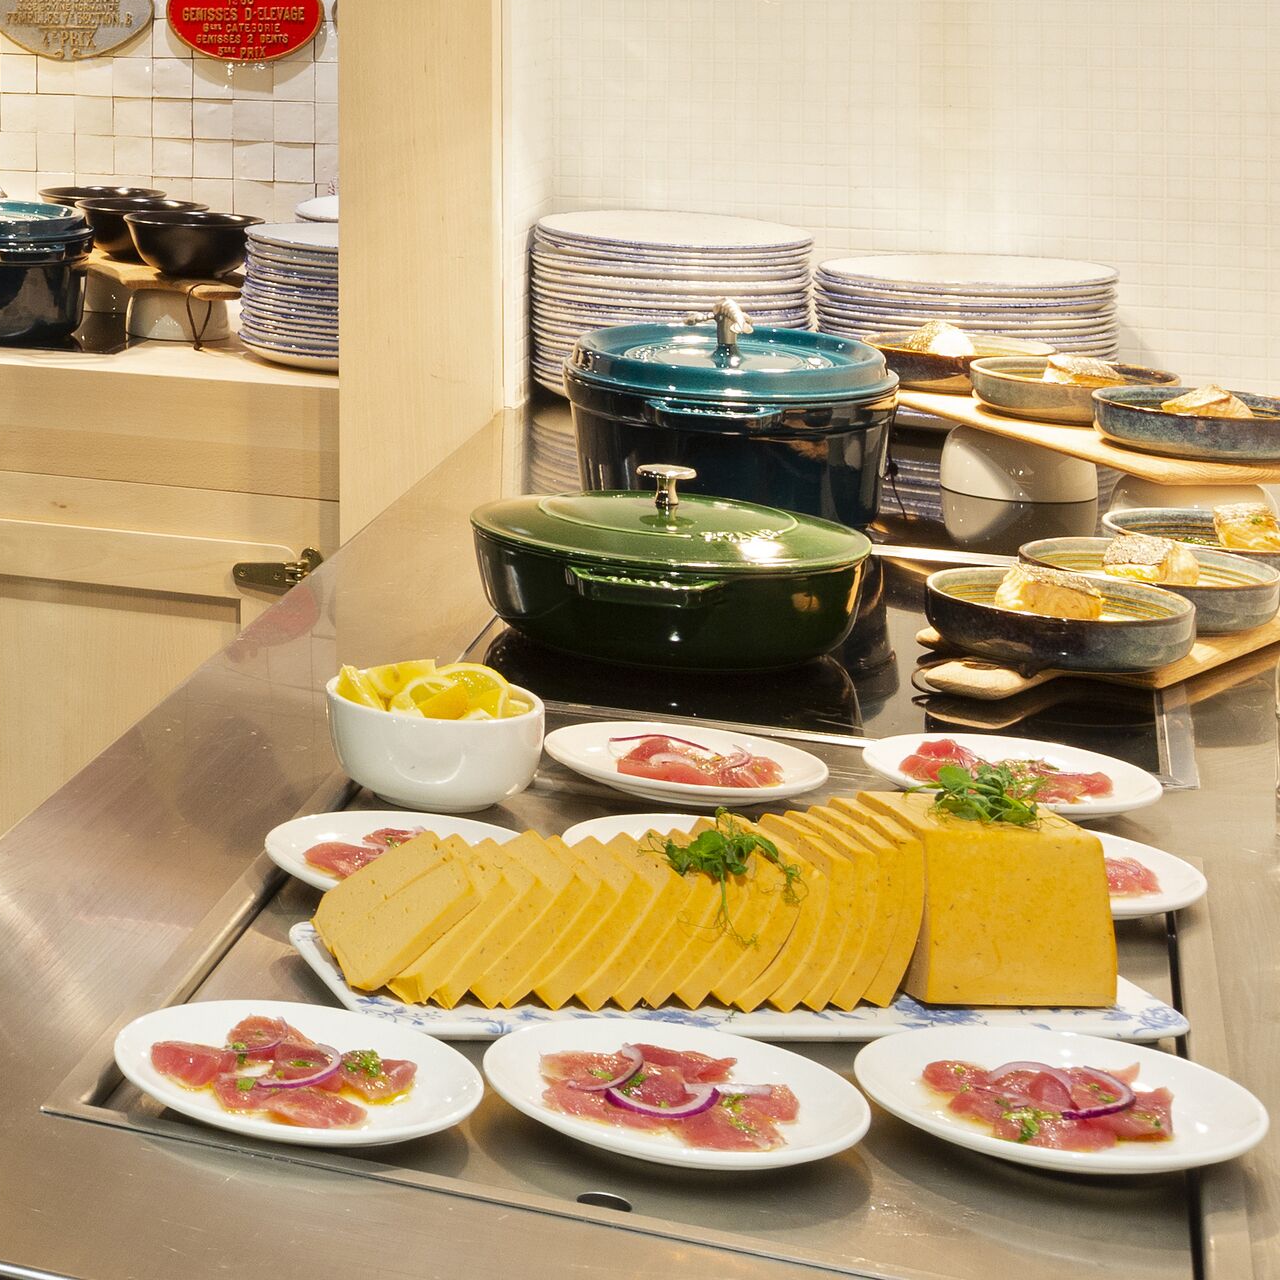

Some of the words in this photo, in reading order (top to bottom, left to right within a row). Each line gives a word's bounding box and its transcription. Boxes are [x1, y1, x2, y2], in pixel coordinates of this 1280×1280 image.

[182, 7, 238, 21] GENISSES
[225, 23, 281, 33] CATEGORIE
[60, 31, 97, 48] PRIX
[195, 34, 242, 44] GENISSES
[239, 46, 267, 59] PRIX
